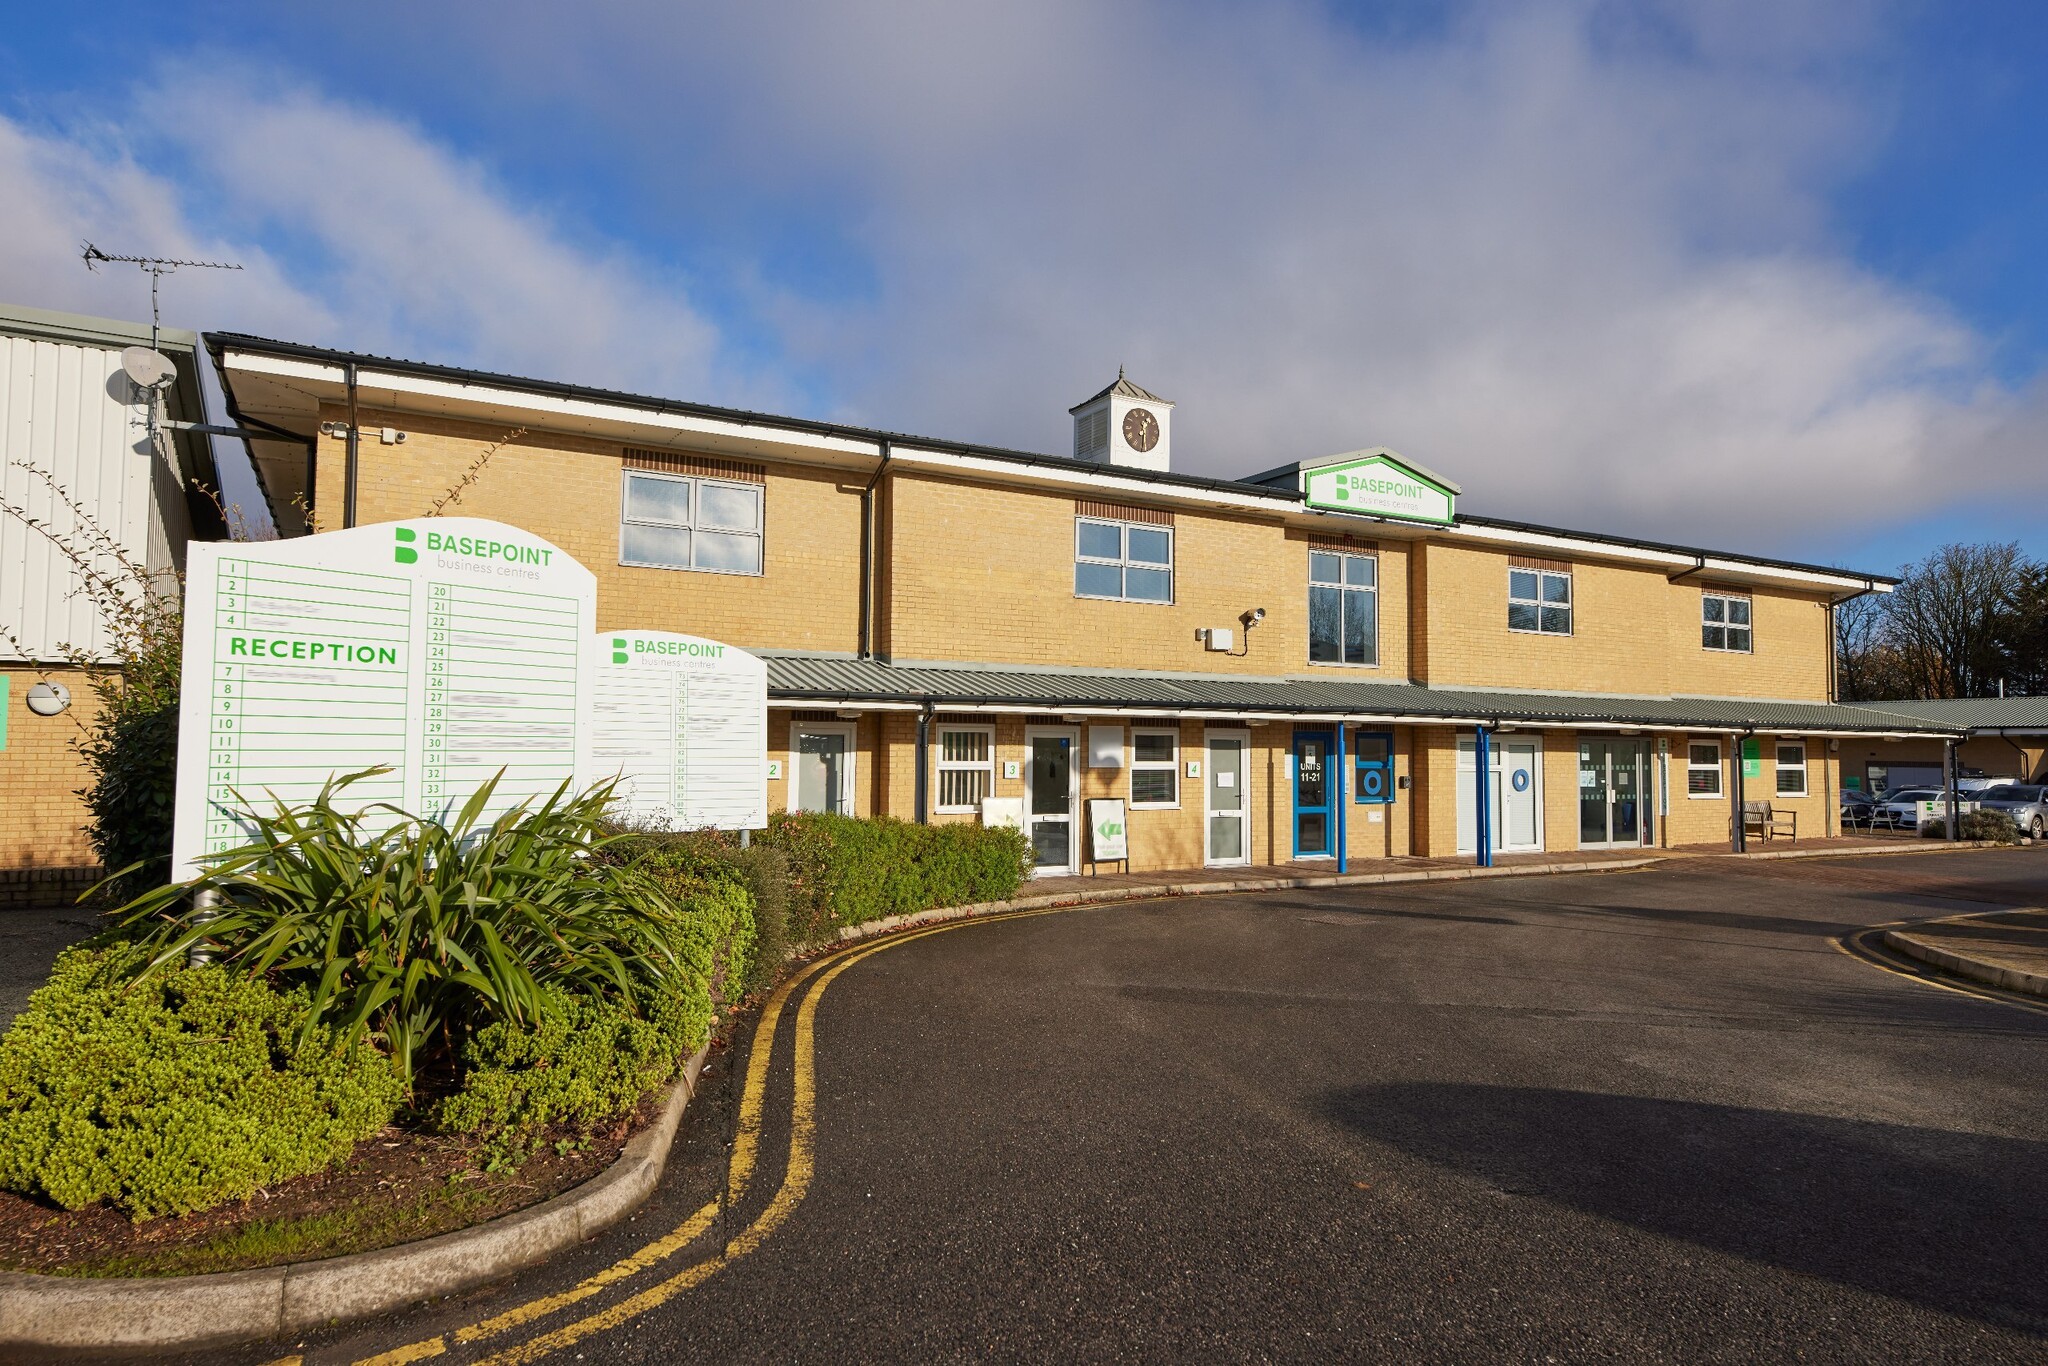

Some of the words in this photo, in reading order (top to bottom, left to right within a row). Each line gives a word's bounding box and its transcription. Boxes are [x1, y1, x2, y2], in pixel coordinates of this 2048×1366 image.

[1351, 476, 1424, 499] BASEPOINT
[427, 532, 552, 566] BASEPOINT
[437, 554, 492, 574] business
[497, 565, 540, 580] centres
[229, 580, 236, 590] 2
[434, 587, 446, 596] 20
[228, 598, 235, 607] 3
[434, 602, 445, 611] 21
[227, 615, 235, 624] 4
[433, 617, 445, 626] 22
[433, 632, 444, 641] 23
[231, 637, 396, 664] RECEPTION
[432, 647, 444, 656] 24
[635, 640, 724, 658] BASEPOINT
[432, 662, 443, 671] 25
[641, 655, 681, 667] business
[683, 659, 716, 669] centres
[225, 667, 232, 676] 7
[431, 678, 443, 686] 26
[224, 684, 231, 693] 8
[430, 693, 442, 701] 27
[223, 701, 230, 711] 9
[430, 708, 442, 716] 28
[219, 719, 233, 728] 10
[429, 723, 441, 732] 29
[220, 736, 231, 746] 11
[429, 739, 441, 747] 30
[218, 754, 231, 763] 12
[429, 754, 440, 762] 31
[428, 769, 440, 778] 32
[769, 764, 777, 775] 2
[1010, 765, 1016, 775] 3
[1191, 765, 1197, 773] 4
[217, 772, 230, 781] 14
[1300, 773, 1320, 781] 11-21
[216, 789, 229, 798] 15
[427, 785, 439, 793] 33
[426, 800, 439, 808] 34
[215, 806, 228, 816] 16
[214, 824, 227, 834] 17
[213, 842, 227, 851] 18
